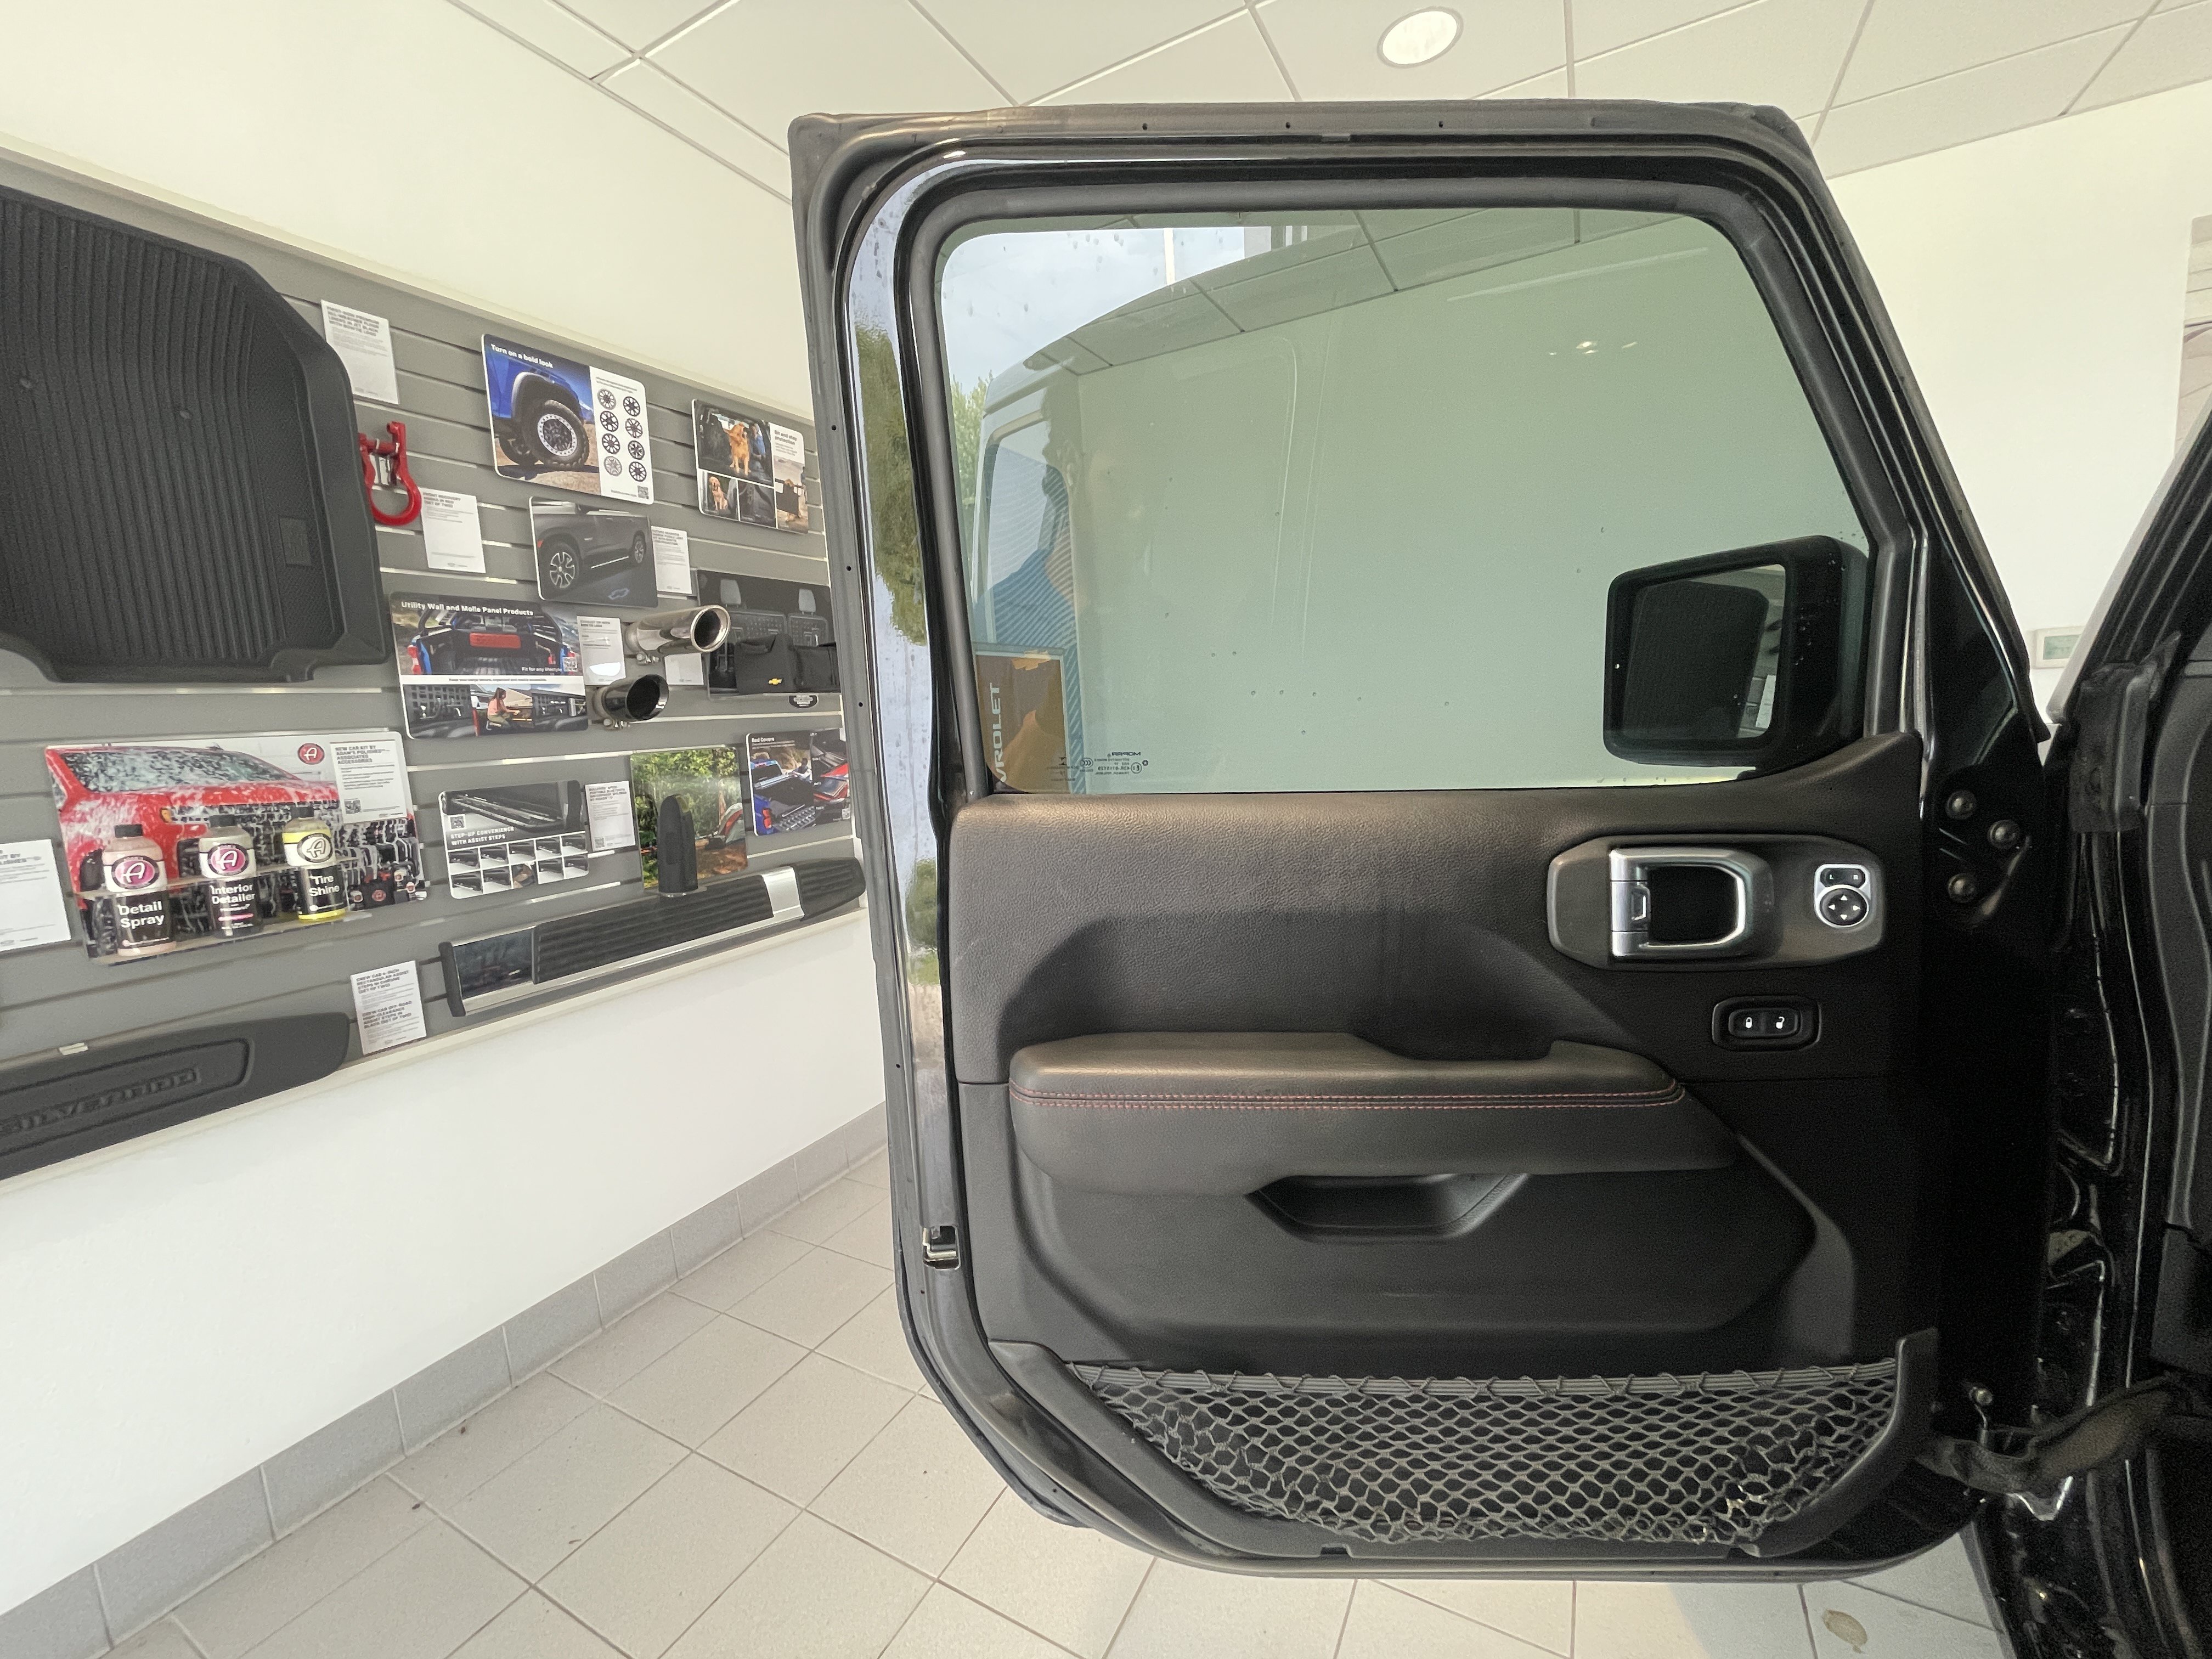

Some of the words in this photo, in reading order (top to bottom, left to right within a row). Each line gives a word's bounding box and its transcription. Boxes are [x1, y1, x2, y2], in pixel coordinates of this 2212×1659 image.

[490, 343, 507, 354] Turn
[523, 354, 538, 364] bold
[539, 359, 554, 368] look
[402, 602, 426, 610] Utility
[309, 875, 334, 885] Tire
[209, 884, 253, 894] Interior
[309, 885, 340, 896] Shine
[212, 893, 256, 905] Detailer
[117, 901, 162, 916] Detail
[120, 915, 165, 929] Spray
